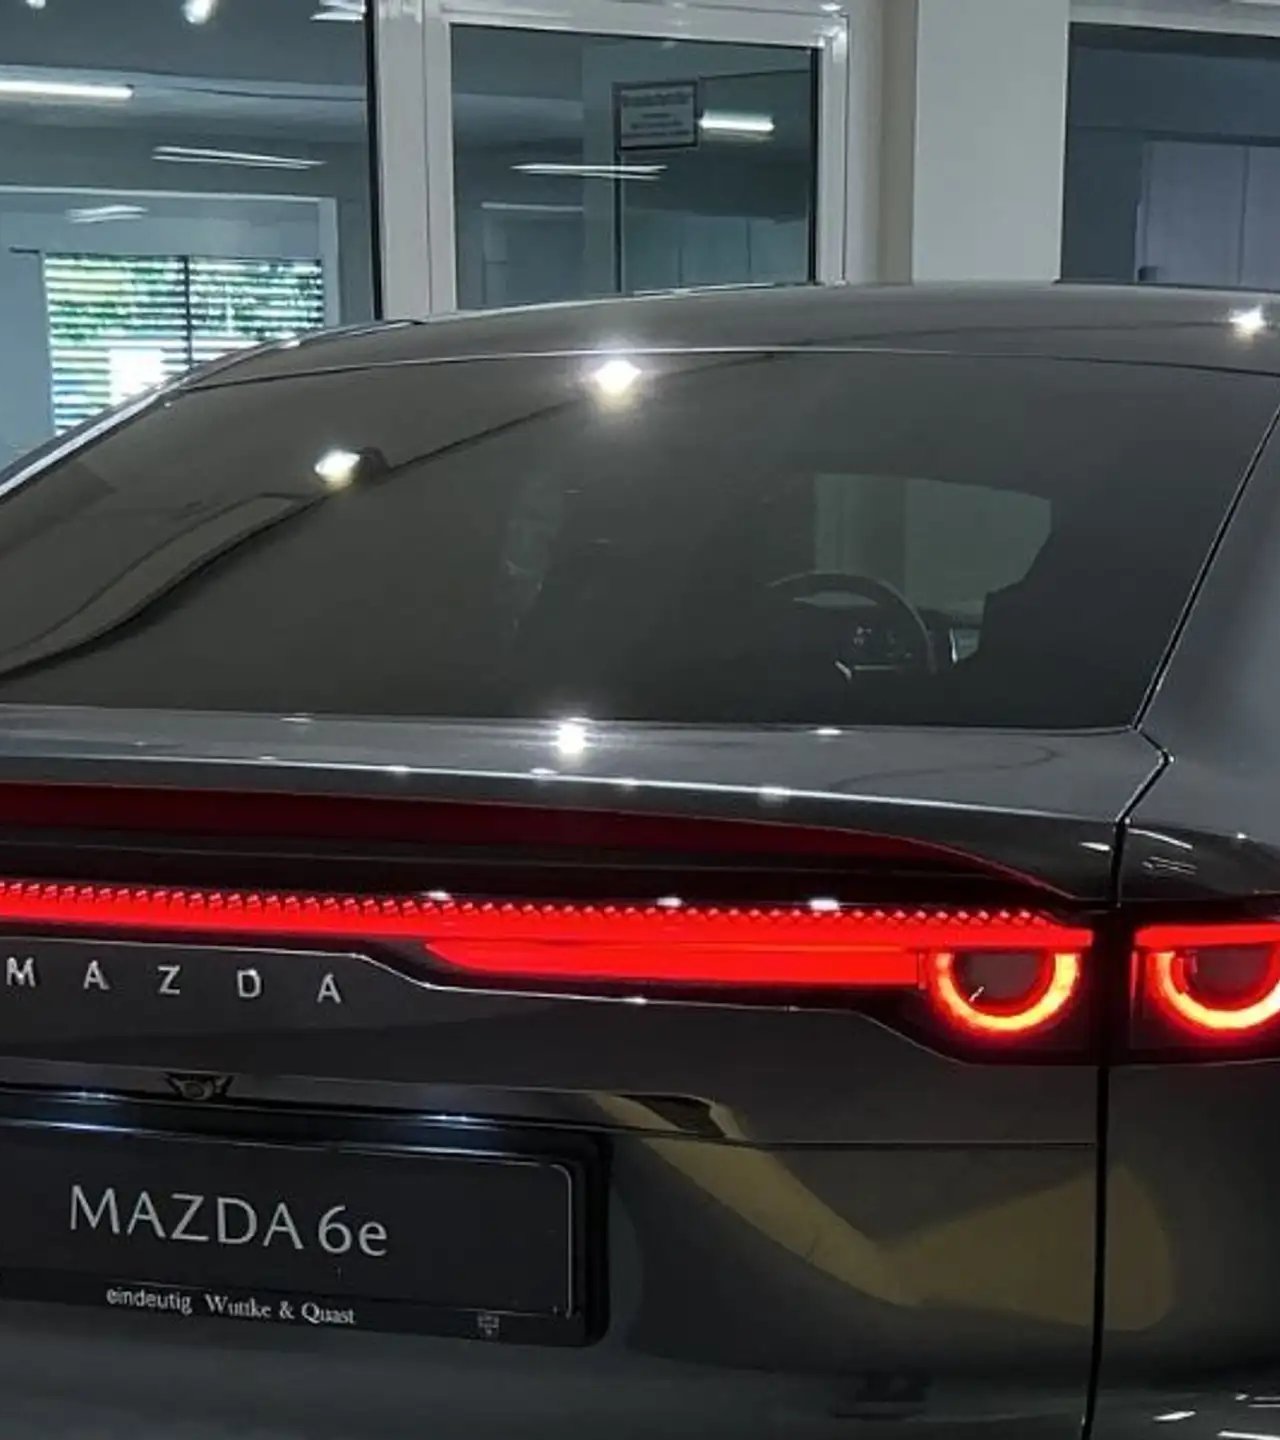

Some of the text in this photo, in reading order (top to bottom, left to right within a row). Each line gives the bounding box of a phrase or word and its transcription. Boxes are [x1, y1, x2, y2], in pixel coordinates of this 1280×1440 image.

[5, 956, 342, 1005] MAZDA
[106, 1287, 193, 1316] eindeutig
[279, 1301, 295, 1320] &
[301, 1301, 356, 1325] Quast
